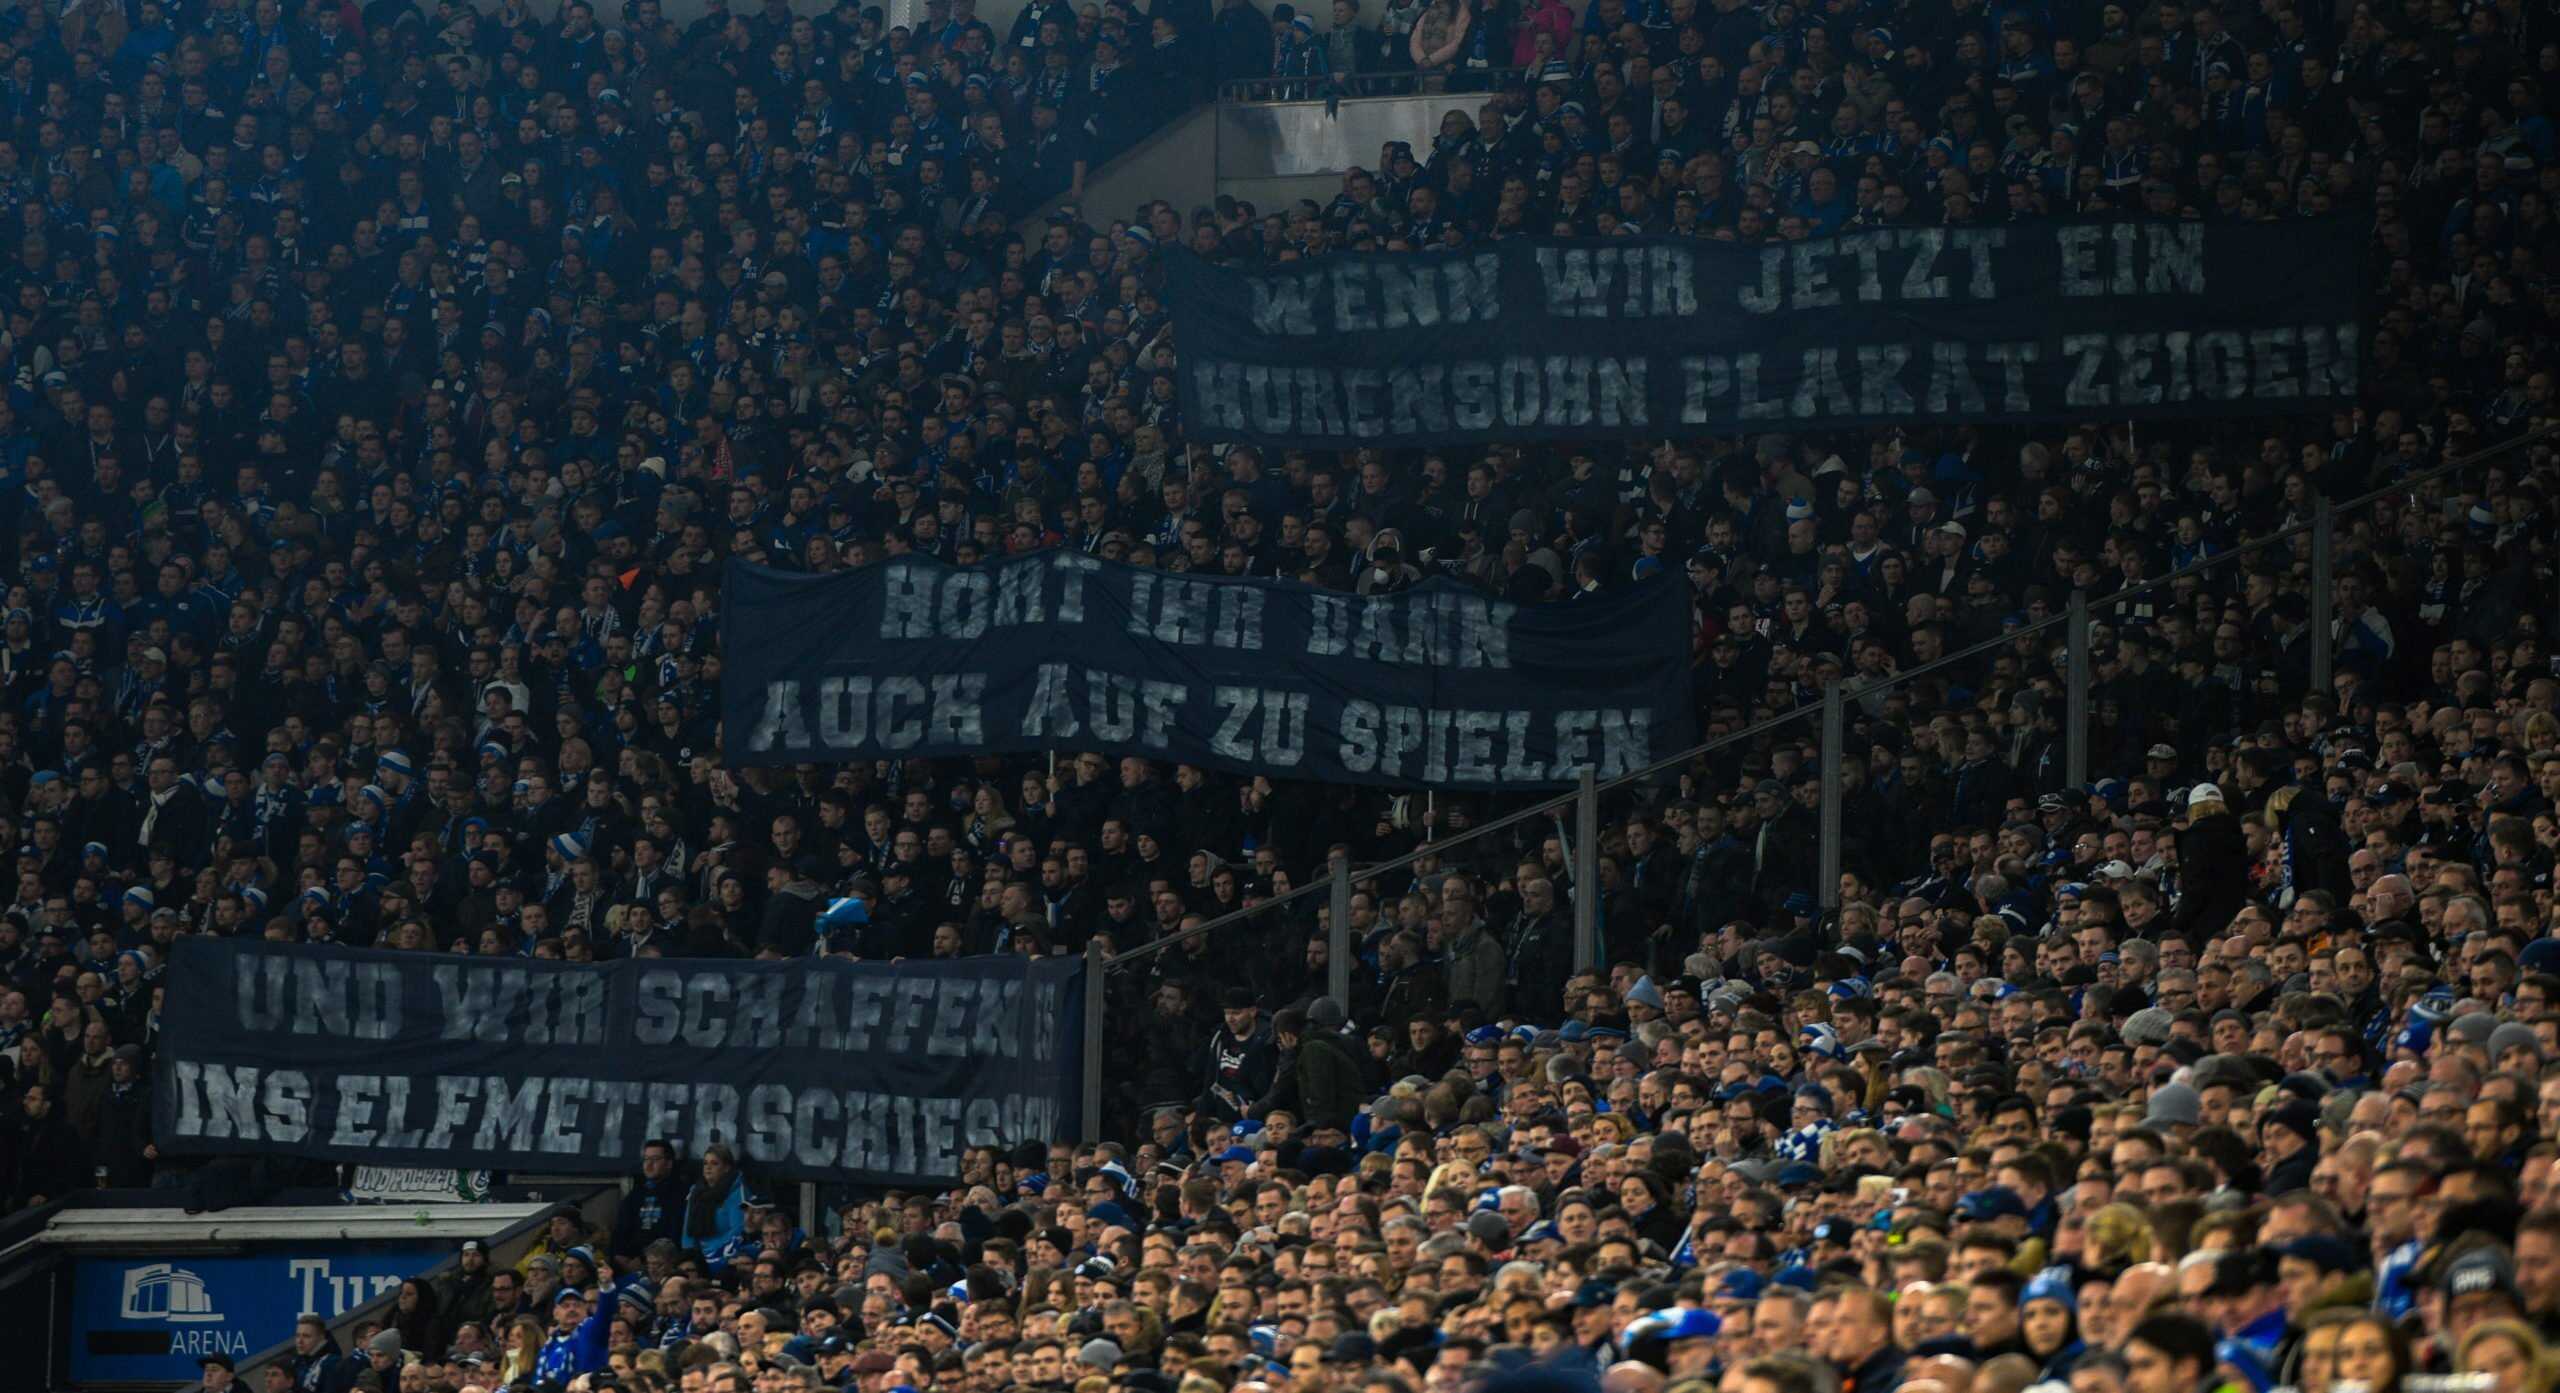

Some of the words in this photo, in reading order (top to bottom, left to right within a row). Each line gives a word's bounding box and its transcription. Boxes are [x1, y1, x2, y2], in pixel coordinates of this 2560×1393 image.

[1247, 253, 1500, 335] WENN
[1536, 247, 1698, 317] WIR
[1738, 227, 2006, 313] JETZT
[2057, 222, 2206, 296] EIN
[1193, 354, 1650, 437] HURENSOHN
[1680, 341, 2040, 423] PLAKAT
[2063, 321, 2360, 407] ZEIGEN
[1126, 573, 1265, 649] IHR
[1307, 592, 1519, 669] DANN
[749, 672, 988, 751] AUCH
[1021, 663, 1188, 748] AUF
[1209, 685, 1310, 766] ZU
[1339, 700, 1653, 784] SPIELEN
[235, 953, 401, 1039] UND
[433, 964, 607, 1044] WIR
[634, 969, 1022, 1058] SCHAFFEN
[175, 1060, 311, 1143] INS
[170, 1330, 249, 1355] ARENA
